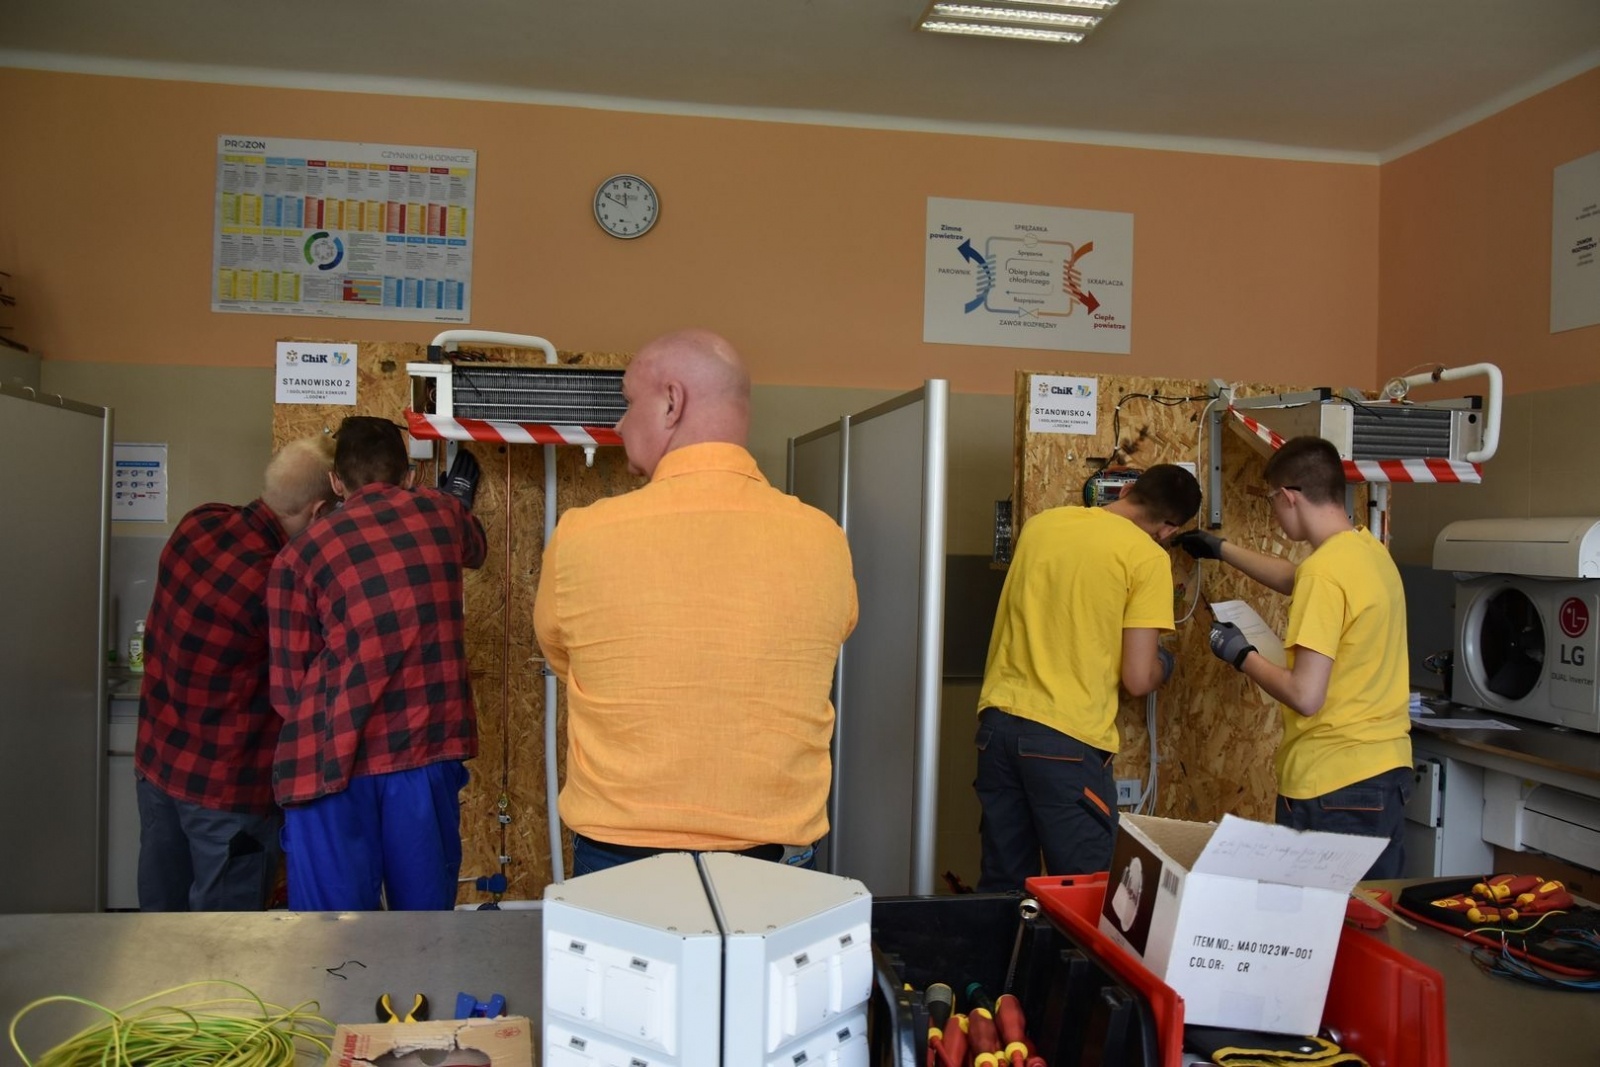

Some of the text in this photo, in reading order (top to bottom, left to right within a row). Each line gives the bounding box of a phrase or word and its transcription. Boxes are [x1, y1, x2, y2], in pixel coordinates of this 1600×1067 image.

[224, 139, 266, 150] PROZON
[381, 151, 470, 164] CZYNNIKI CHŁODNICZE
[940, 224, 962, 232] Zimne
[1014, 223, 1049, 233] SPRĘŻARKA
[929, 232, 964, 241] powietrze
[938, 267, 972, 276] PAROWNIK
[1008, 268, 1050, 278] Obieg środka
[1008, 276, 1050, 286] chłodniczego
[1087, 278, 1124, 287] SKRAPLACZA
[1093, 313, 1115, 322] Ciepłe
[998, 318, 1022, 327] ZAWÓR
[1093, 322, 1126, 331] powietrze
[301, 353, 328, 364] ChiK
[282, 378, 343, 387] STANOWISKO
[1051, 386, 1073, 395] ChiK
[1035, 408, 1085, 417] STANOWISKO
[1560, 644, 1585, 667] LG
[1551, 672, 1567, 682] DUAL
[1192, 935, 1313, 960] ITEM NO.: MA01023W-001
[1189, 956, 1250, 973] COLOR: CR
